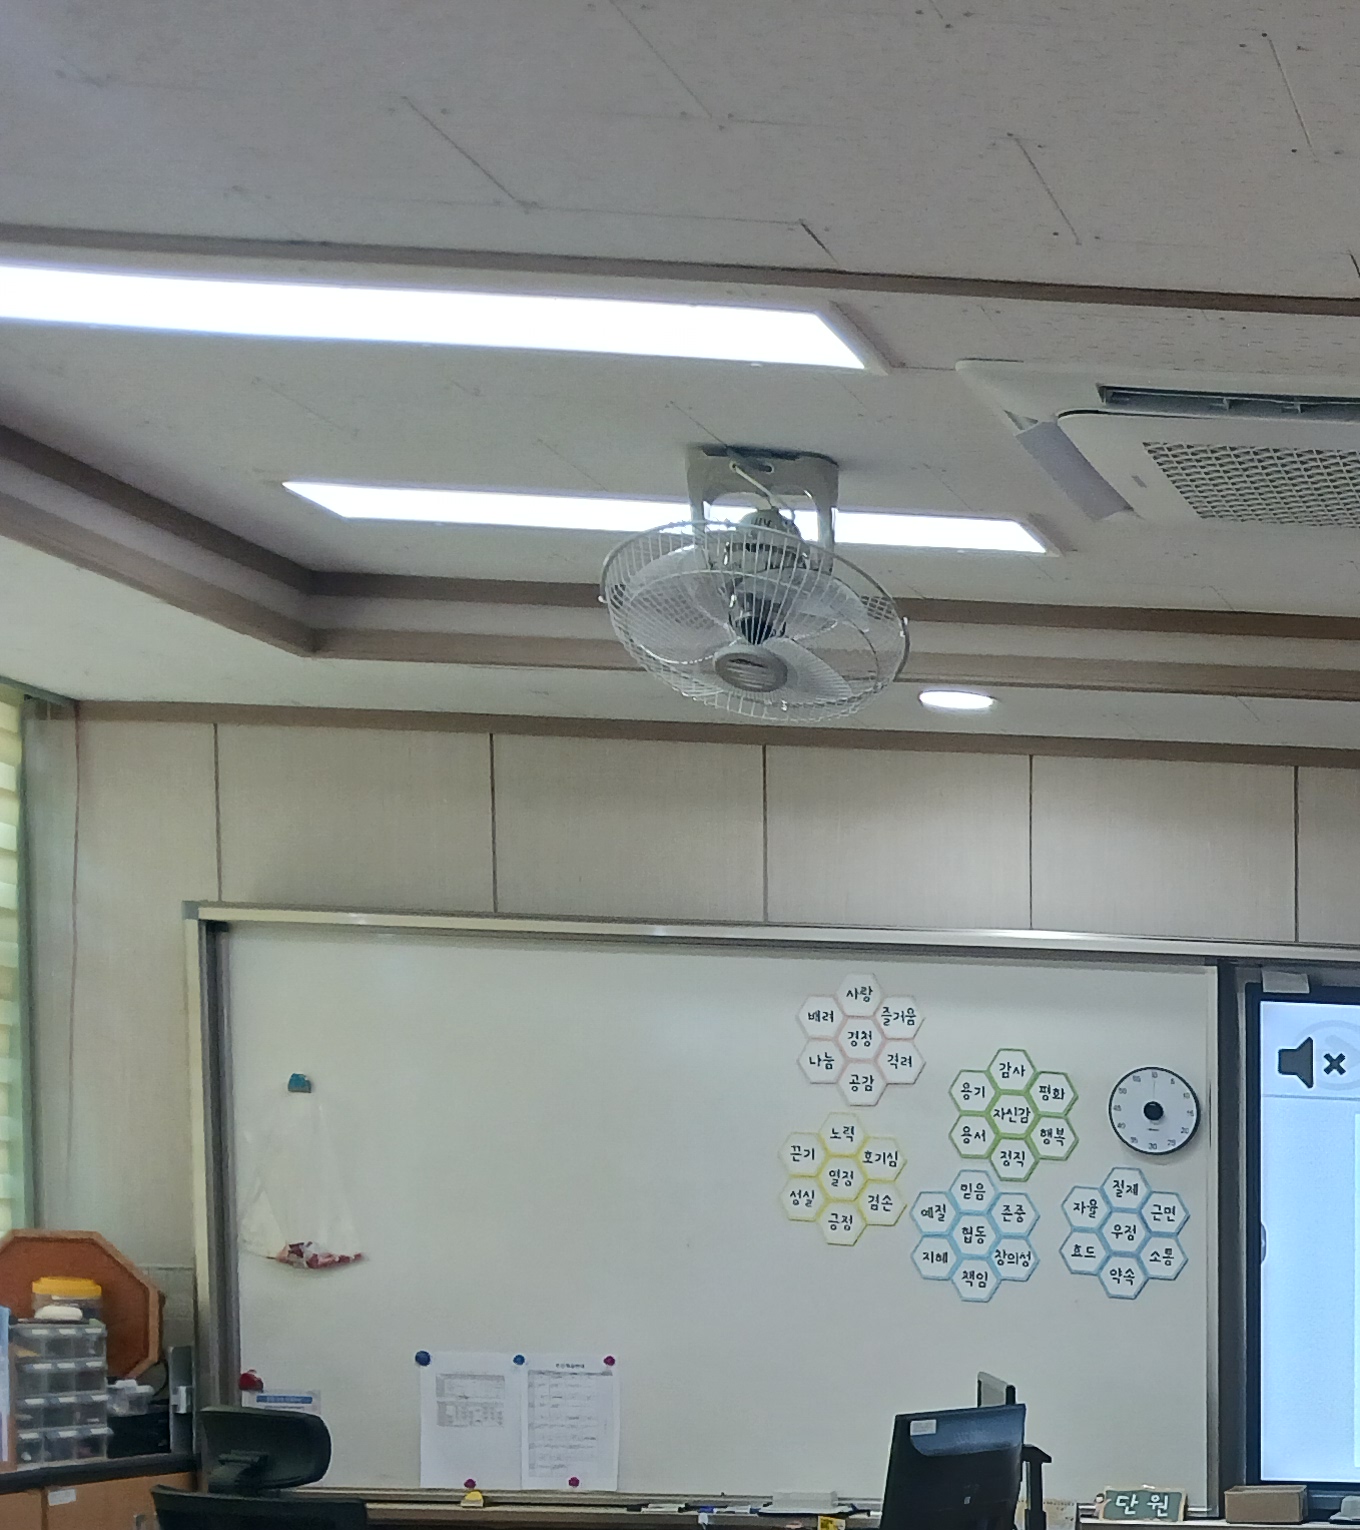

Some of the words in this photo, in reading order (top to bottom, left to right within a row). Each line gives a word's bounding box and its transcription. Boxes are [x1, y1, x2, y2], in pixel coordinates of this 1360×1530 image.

[846, 986, 873, 1002] 사랑
[808, 1010, 834, 1022] 배려
[881, 1006, 917, 1026] 즐거움
[847, 1030, 872, 1047] 경청
[809, 1052, 835, 1069] 나눔
[999, 1062, 1026, 1079] 감사
[849, 1074, 874, 1092] 공감
[961, 1082, 985, 1100] 용기
[1039, 1084, 1065, 1101] 평화
[993, 1107, 1031, 1123] 자신감
[830, 1126, 855, 1142] 노력
[961, 1126, 986, 1144] 용서
[1040, 1128, 1066, 1146] 행복
[790, 1145, 815, 1162] 끈기
[862, 1150, 898, 1167] 호기심
[1000, 1150, 1025, 1167] 정직
[829, 1169, 854, 1187] 열정
[790, 1189, 815, 1207] 성실
[960, 1183, 986, 1201] 믿음
[1112, 1180, 1139, 1198] 절제
[921, 1204, 946, 1222] 예절
[1001, 1205, 1026, 1223] 존중
[1073, 1199, 1099, 1219] 자율
[828, 1213, 853, 1231] 긍정
[962, 1226, 986, 1244] 협동
[1111, 1224, 1136, 1241] 우정
[923, 1251, 948, 1264] 지혜
[994, 1249, 1031, 1267] 창의성
[962, 1270, 988, 1288] 책임
[1109, 1267, 1135, 1286] 약속
